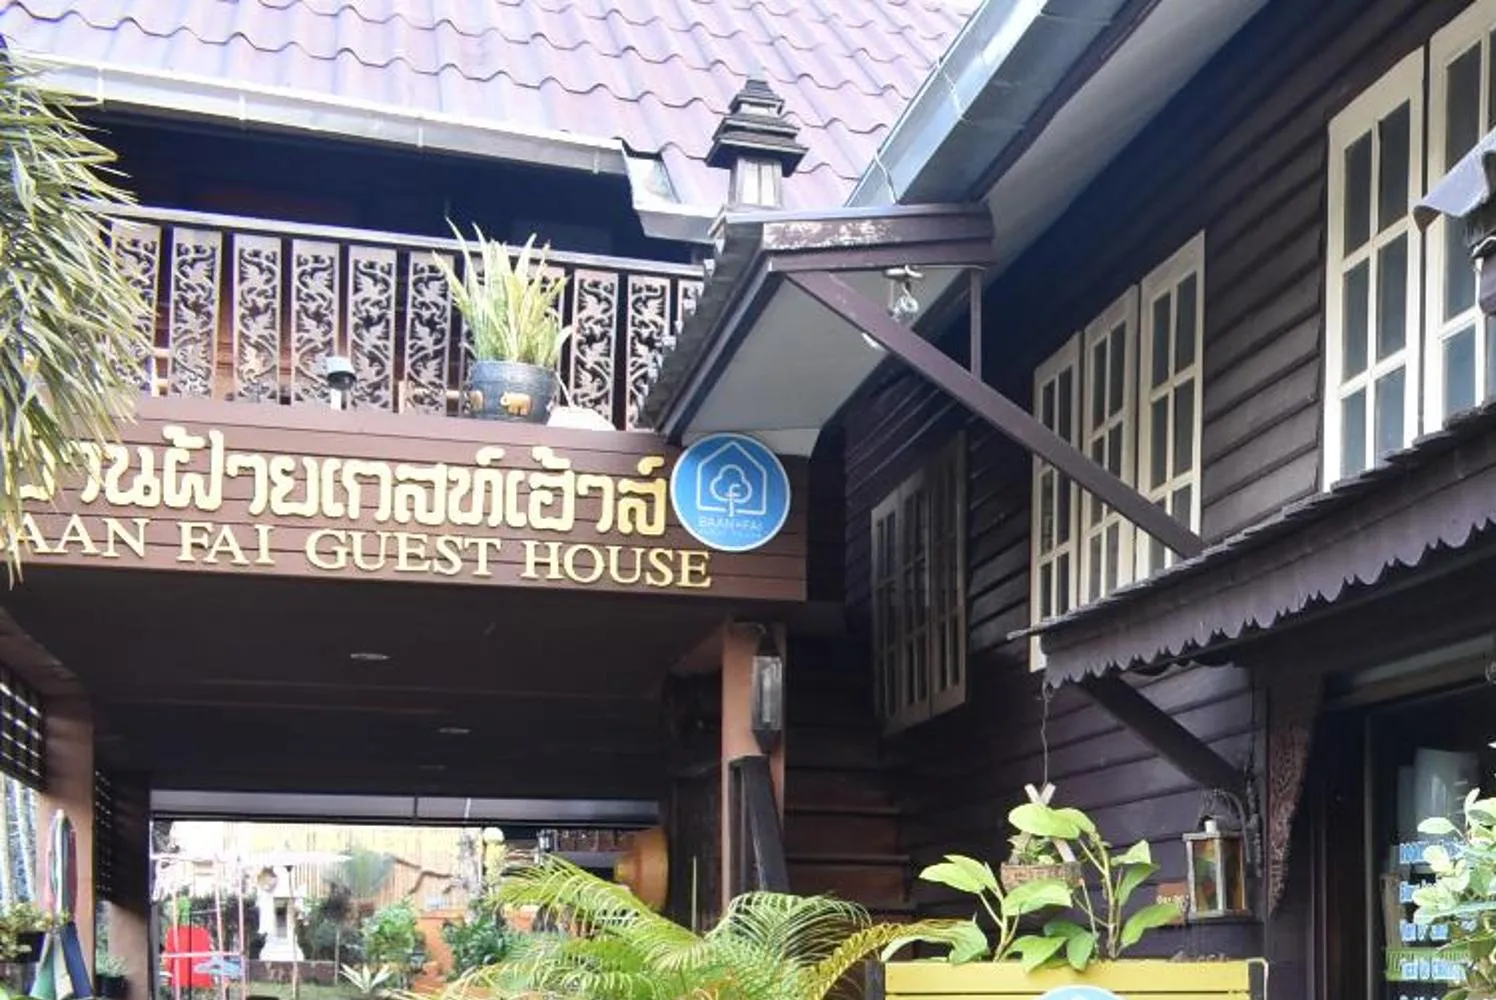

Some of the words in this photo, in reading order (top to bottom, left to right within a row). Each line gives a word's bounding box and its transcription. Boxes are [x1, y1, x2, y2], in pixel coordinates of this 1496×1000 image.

[3, 424, 667, 537] านฝ้ายเกสท์เฮ้าส์
[0, 511, 150, 559] AAN
[176, 519, 275, 568] FAI
[305, 528, 502, 579] GUEST
[519, 538, 713, 589] HOUSE
